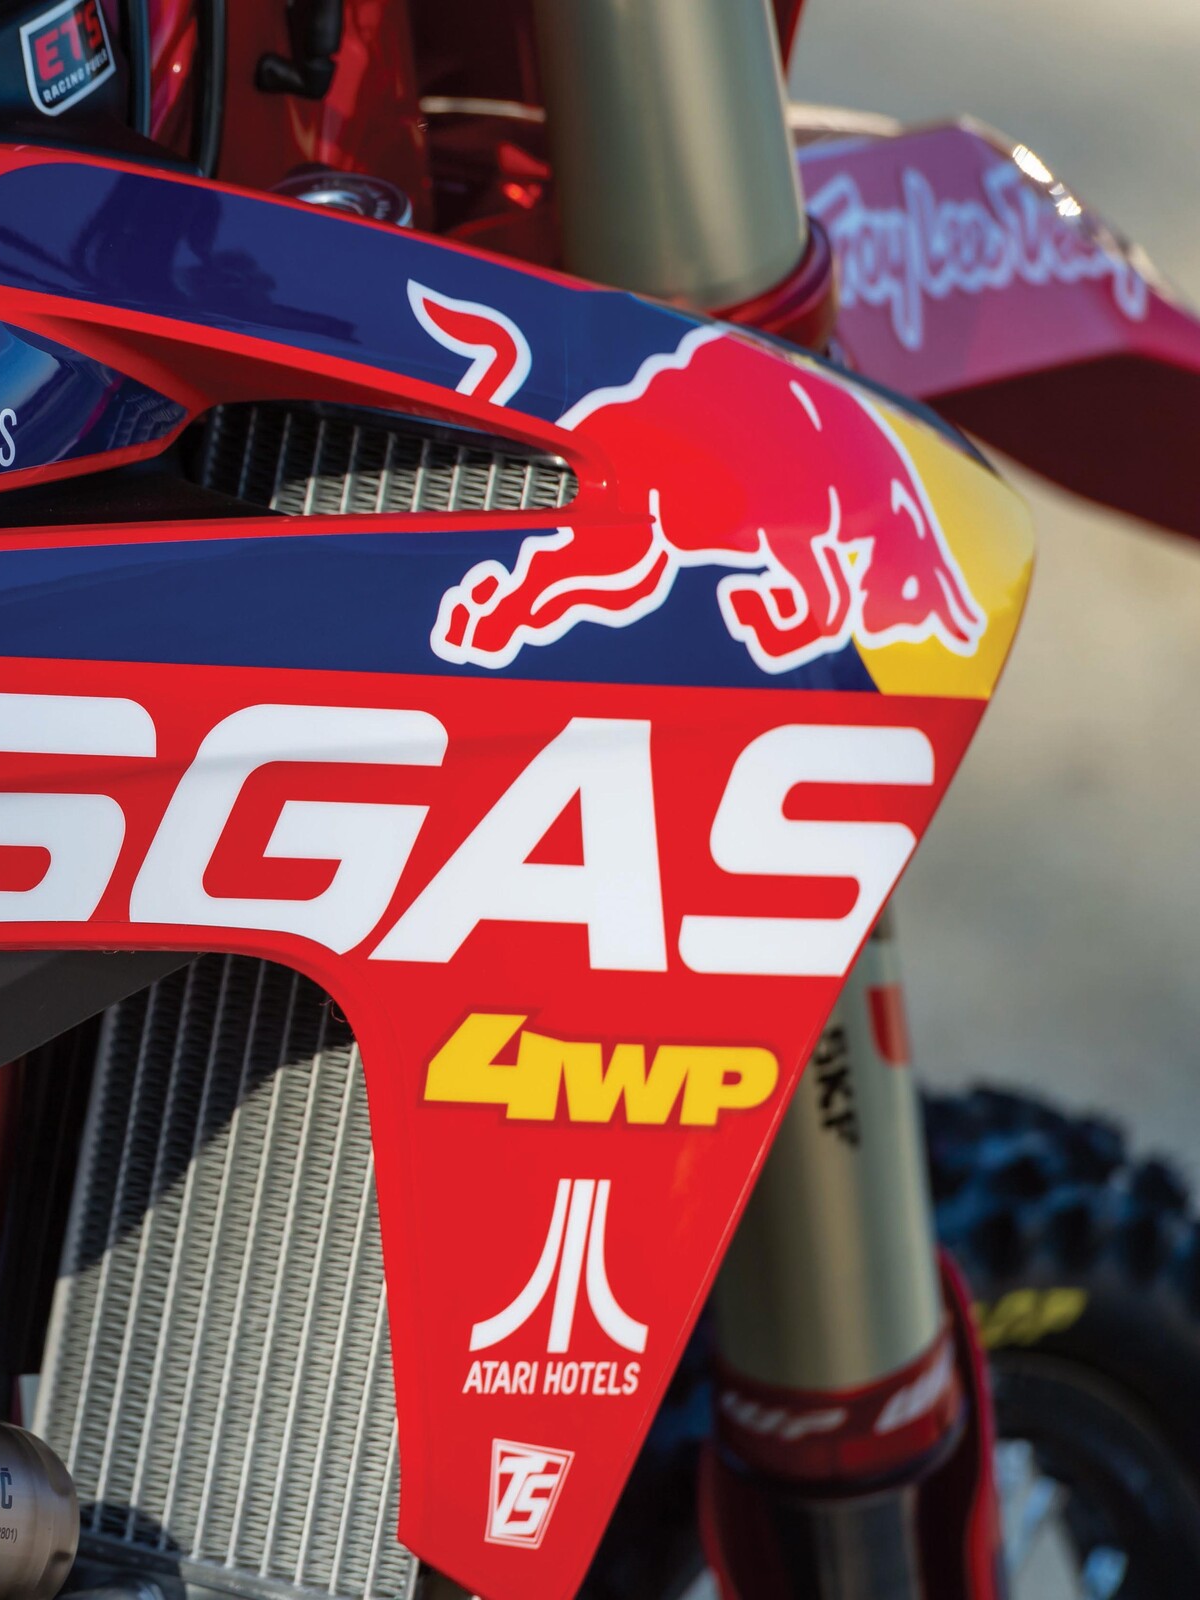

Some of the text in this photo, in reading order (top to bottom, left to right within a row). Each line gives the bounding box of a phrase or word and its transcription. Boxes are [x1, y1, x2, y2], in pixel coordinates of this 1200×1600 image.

[34, 0, 103, 81] ETS
[42, 67, 85, 103] RACING
[423, 1013, 780, 1126] 4WP
[462, 1360, 641, 1396] ATARI HOTELS
